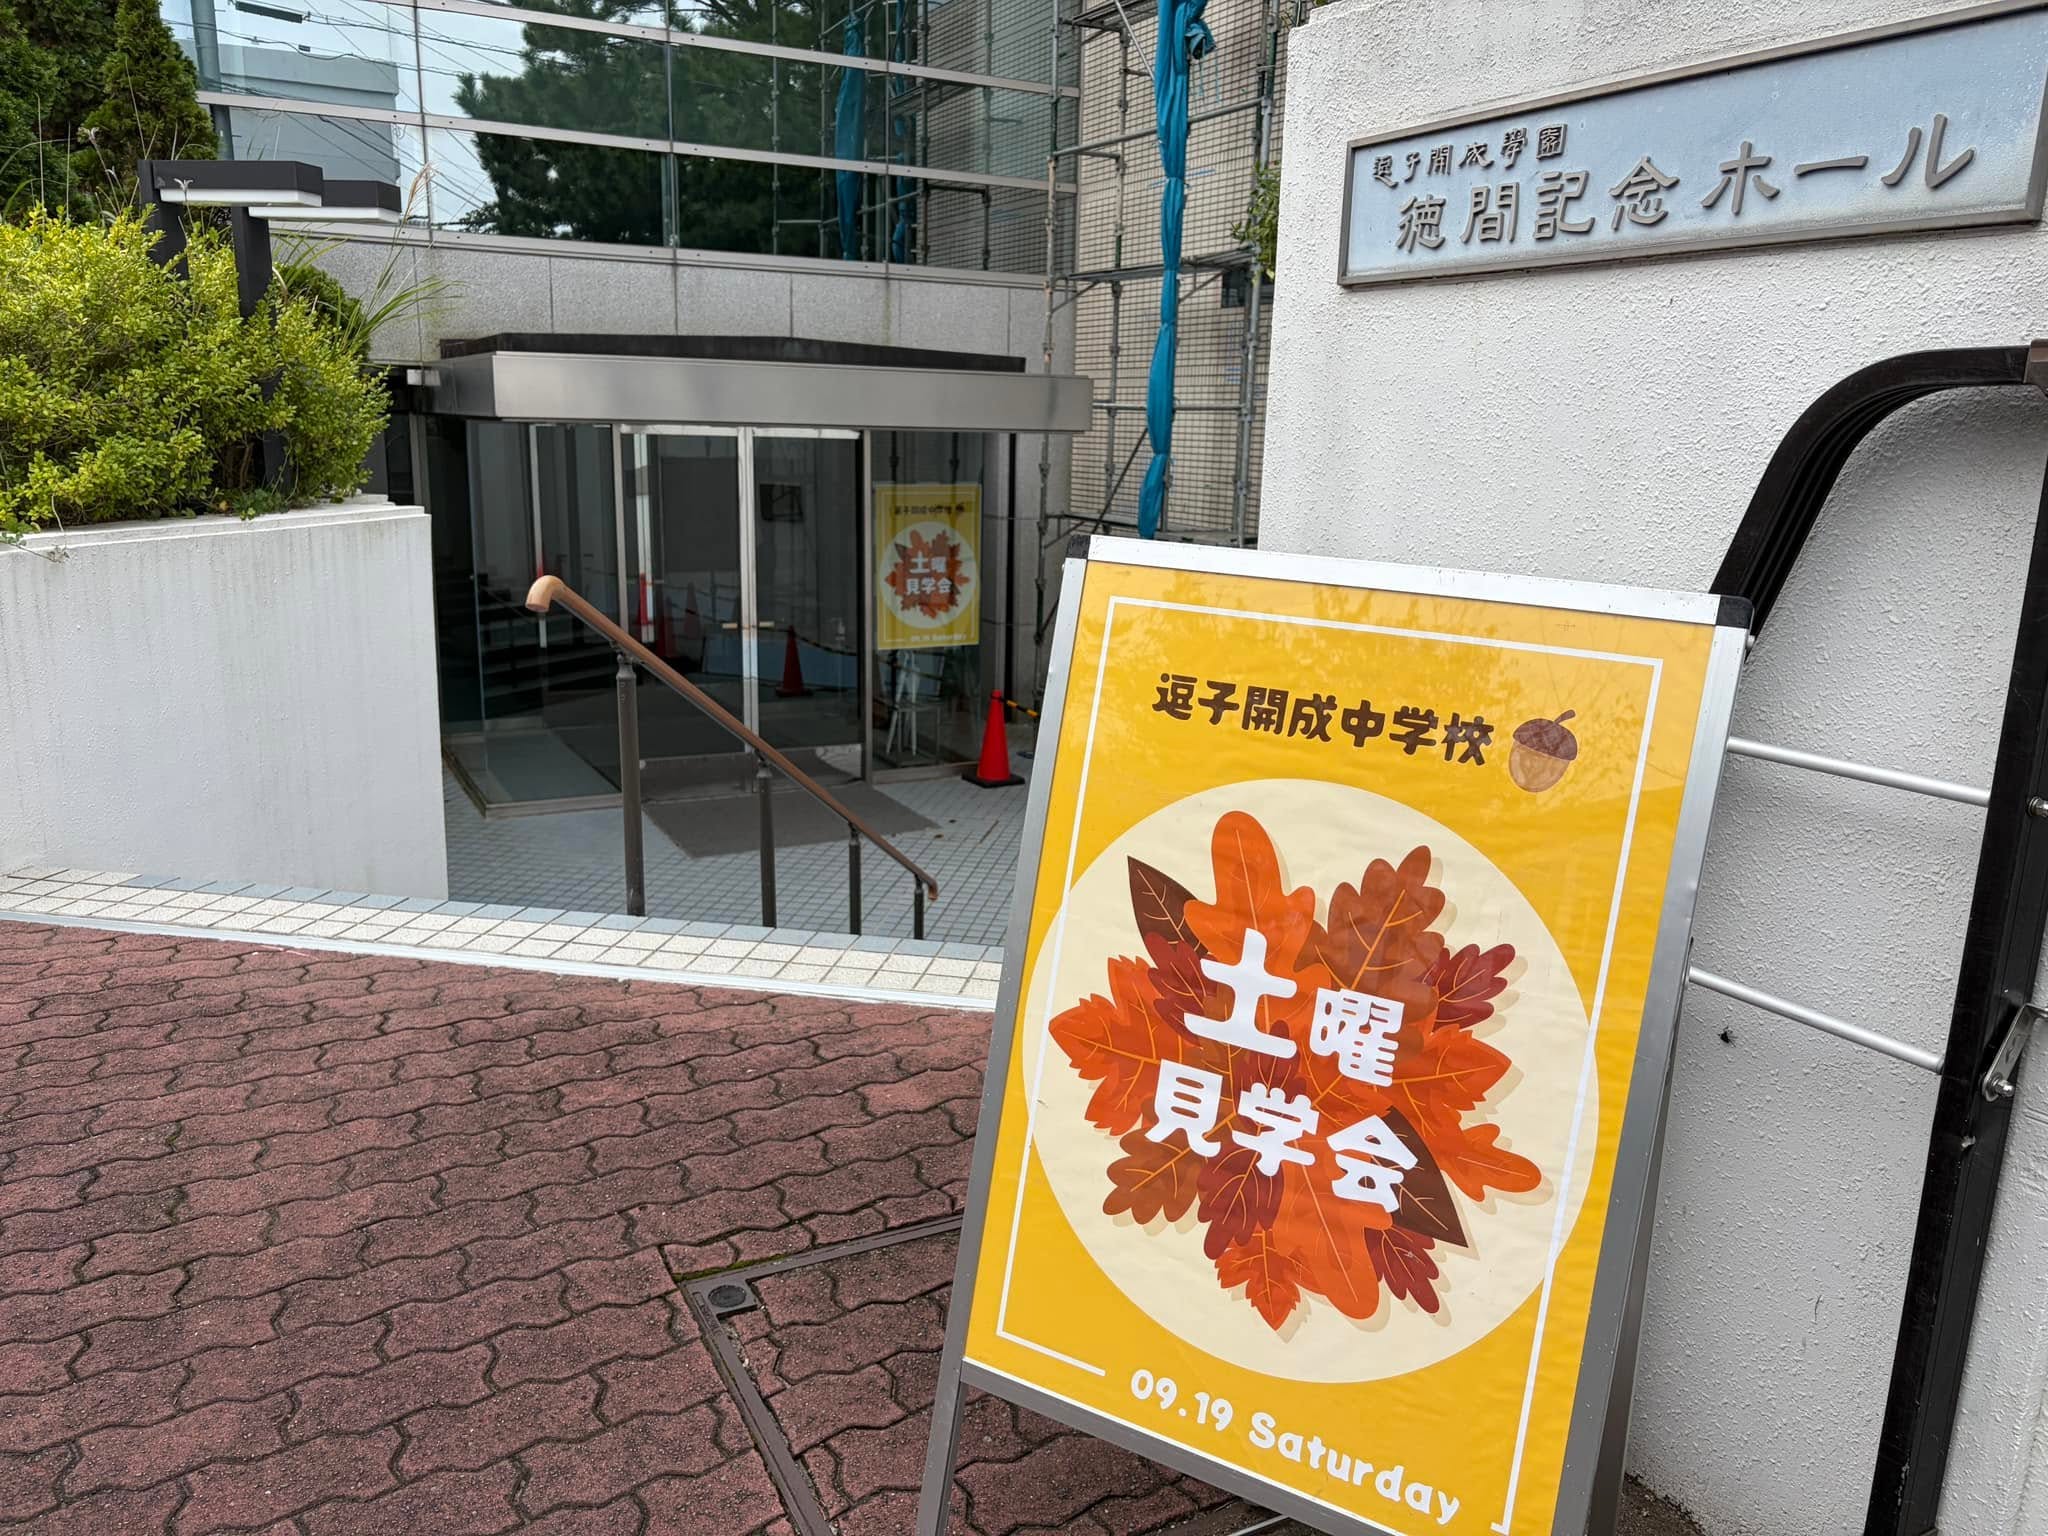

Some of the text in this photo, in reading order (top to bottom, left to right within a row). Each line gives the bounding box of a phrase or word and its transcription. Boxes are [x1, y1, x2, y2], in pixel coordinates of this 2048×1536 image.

[1396, 113, 1975, 254] 徳間記念ホール
[906, 577, 953, 595] 見学会
[1152, 673, 1495, 766] 逗子開成中学校
[1183, 927, 1405, 1087] 土曜
[1145, 1059, 1418, 1213] 見学会
[1130, 1369, 1460, 1525] 09.19 Saturday
